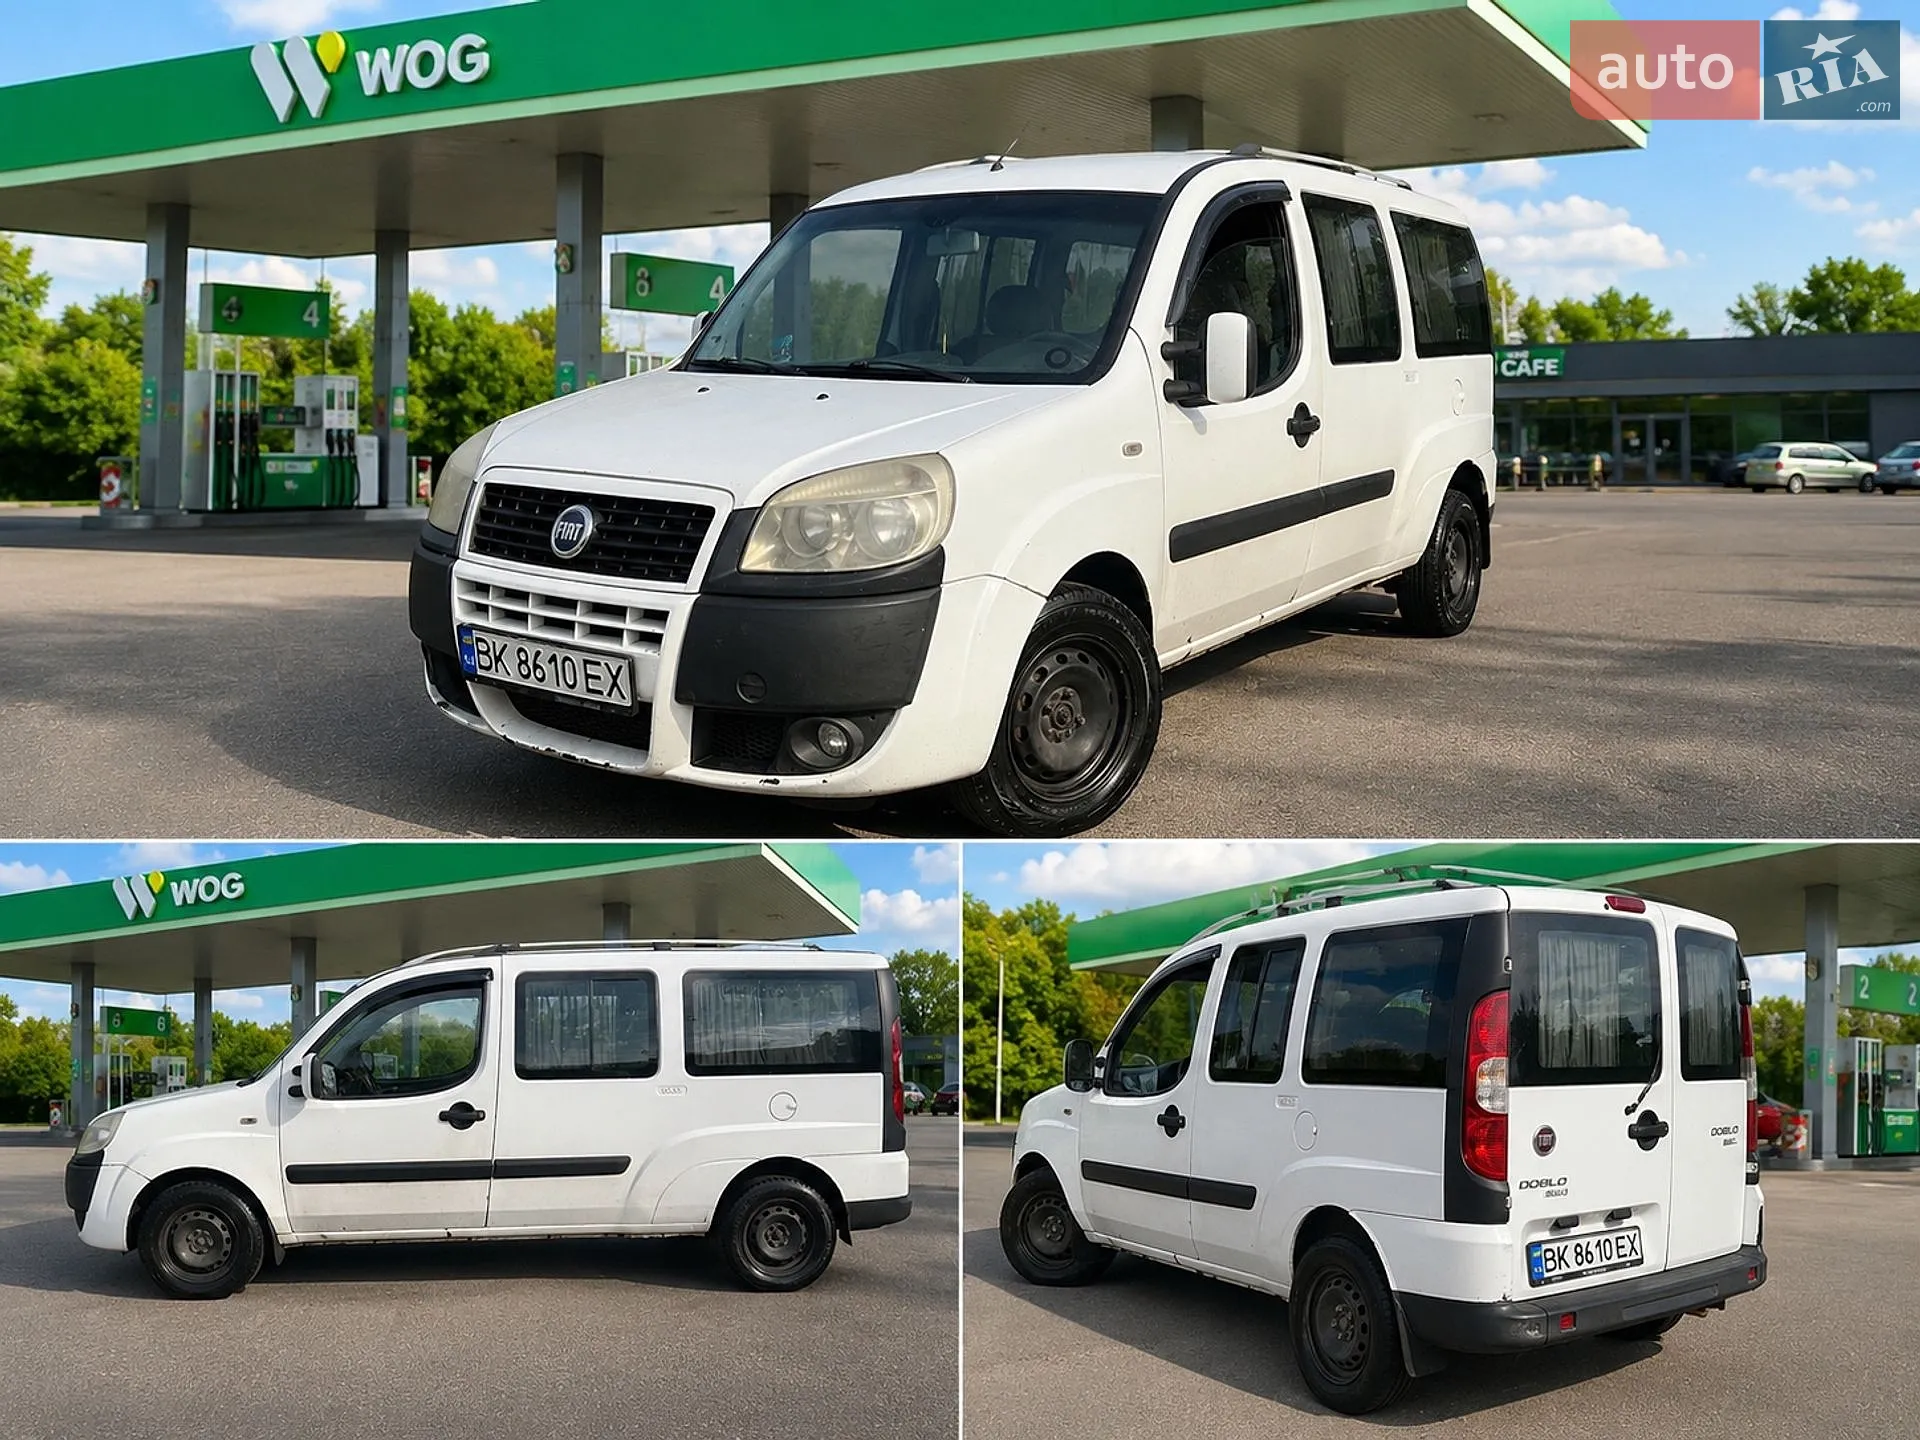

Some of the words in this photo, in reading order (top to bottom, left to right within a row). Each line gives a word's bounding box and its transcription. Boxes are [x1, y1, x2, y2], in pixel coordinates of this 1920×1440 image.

[355, 33, 490, 97] WOG
[709, 275, 726, 304] 4
[302, 300, 320, 328] 4
[1500, 358, 1559, 377] CAFE
[555, 521, 584, 541] FIAT
[474, 636, 512, 677] BK
[515, 646, 578, 690] 8610
[582, 658, 627, 701] EX
[169, 872, 245, 906] WOG
[1859, 974, 1870, 1000] 2
[1908, 982, 1918, 1007] 2
[1518, 1177, 1568, 1190] DOBLO
[1543, 1244, 1570, 1273] BK
[1573, 1238, 1613, 1266] 8610
[1615, 1233, 1639, 1259] EX
